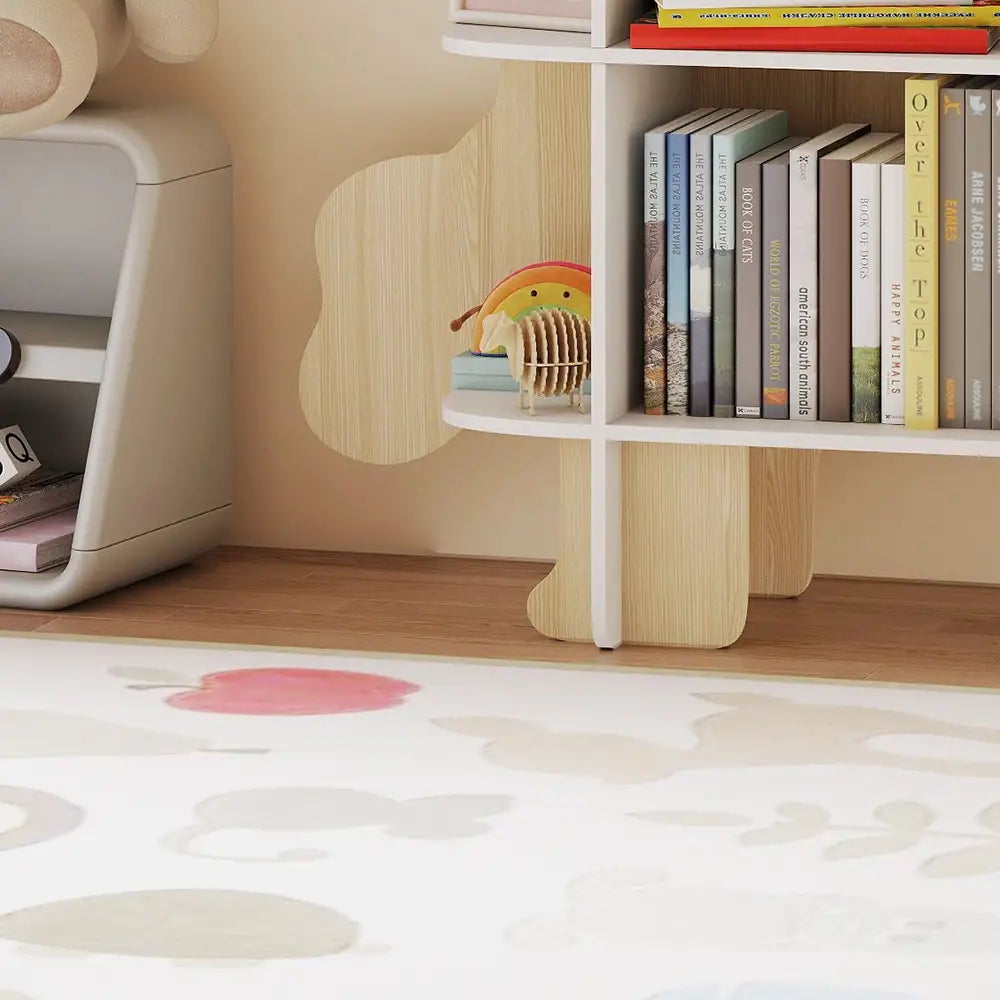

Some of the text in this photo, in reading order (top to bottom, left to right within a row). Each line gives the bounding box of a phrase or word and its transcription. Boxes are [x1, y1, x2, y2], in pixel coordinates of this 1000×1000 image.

[911, 92, 929, 173] Over
[741, 187, 753, 264] BOOK OF CATS
[859, 198, 870, 280] BOOK OF DOGS
[911, 201, 929, 257] the
[944, 199, 957, 241] EAMES
[971, 171, 984, 272] ARNE JACOBSEN
[768, 239, 781, 382] WORLD OF EGZOTIC PARROT
[891, 284, 901, 395] HAPPY ANIMALS
[798, 287, 811, 416] american south animals
[5, 433, 35, 463] Q
